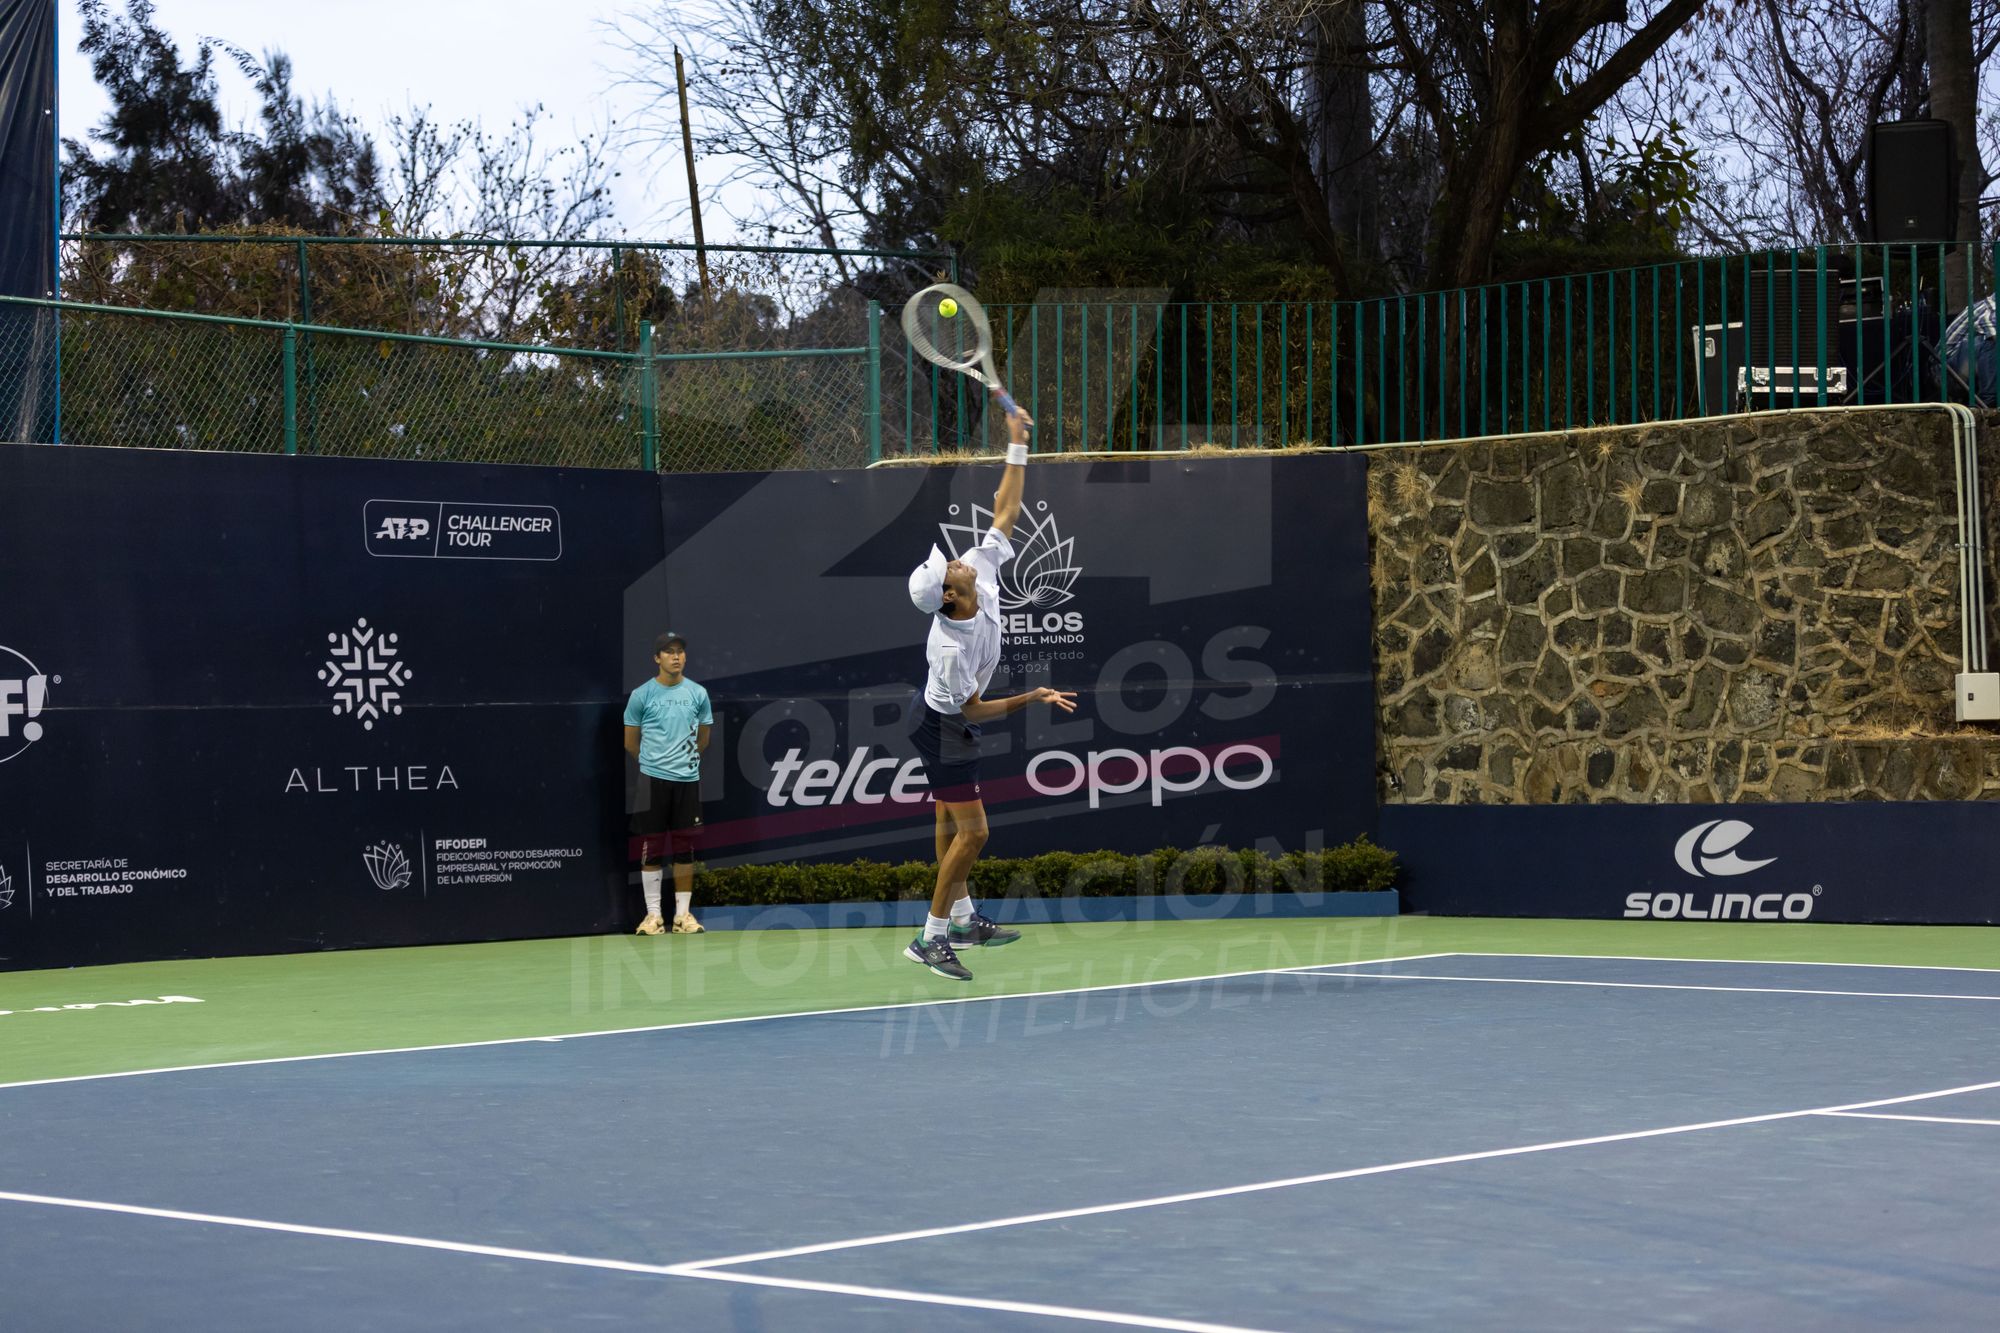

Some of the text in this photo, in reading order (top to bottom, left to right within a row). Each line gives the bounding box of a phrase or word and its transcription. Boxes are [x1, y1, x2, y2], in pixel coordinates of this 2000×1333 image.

[373, 517, 430, 540] ATP
[448, 515, 552, 533] CHALLENGER
[447, 531, 492, 547] TOUR
[1000, 612, 1084, 634] RELOS
[1014, 636, 1036, 645] DEL
[1040, 634, 1084, 644] MUNDO
[1013, 651, 1032, 662] del
[1039, 650, 1084, 661] Estado
[991, 663, 1049, 674] 18-2024
[285, 765, 459, 793] ALTHEA
[767, 746, 936, 807] telce
[1026, 744, 1273, 809] oppo
[435, 838, 487, 850] FIFODEPI
[436, 848, 583, 862] FIDEICOMISO FONDO DESARROLLO
[46, 858, 128, 871] SECRETARÍA DE
[437, 860, 562, 873] EMPRESARIAL Y PROMOCIÓN
[46, 868, 187, 884] DESARROLLO ECONÓMICO
[437, 873, 512, 885] DE LA INVERSIÓN
[47, 884, 133, 897] Y DEL TRABAJO
[1624, 892, 1814, 920] SOLINCO
